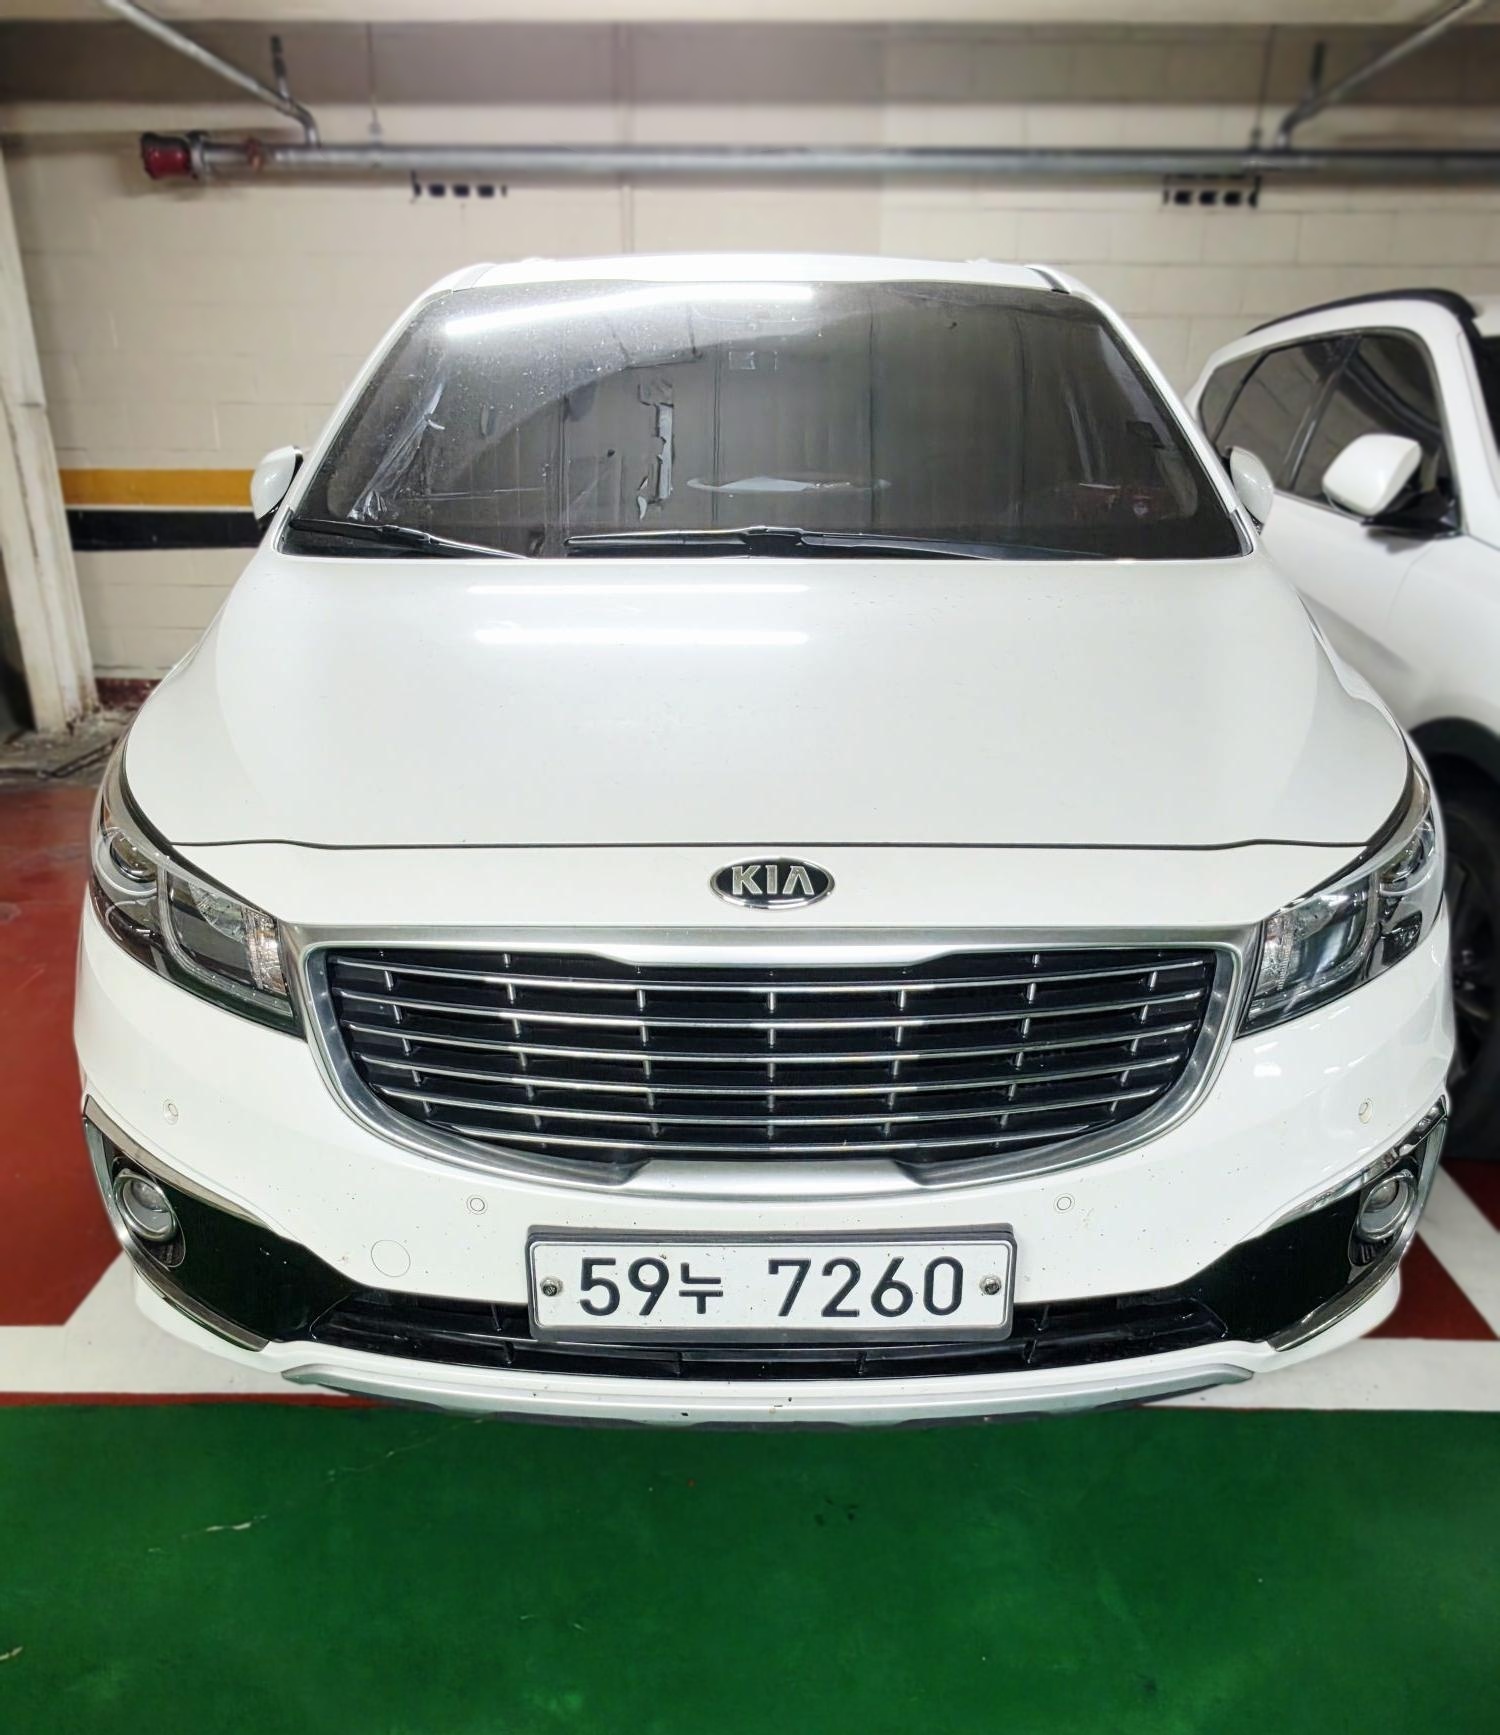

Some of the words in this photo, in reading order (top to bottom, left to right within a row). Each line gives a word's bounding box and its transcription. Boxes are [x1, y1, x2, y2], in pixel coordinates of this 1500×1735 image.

[732, 865, 815, 895] KIA
[580, 1256, 723, 1316] 59누
[768, 1256, 964, 1318] 7260
